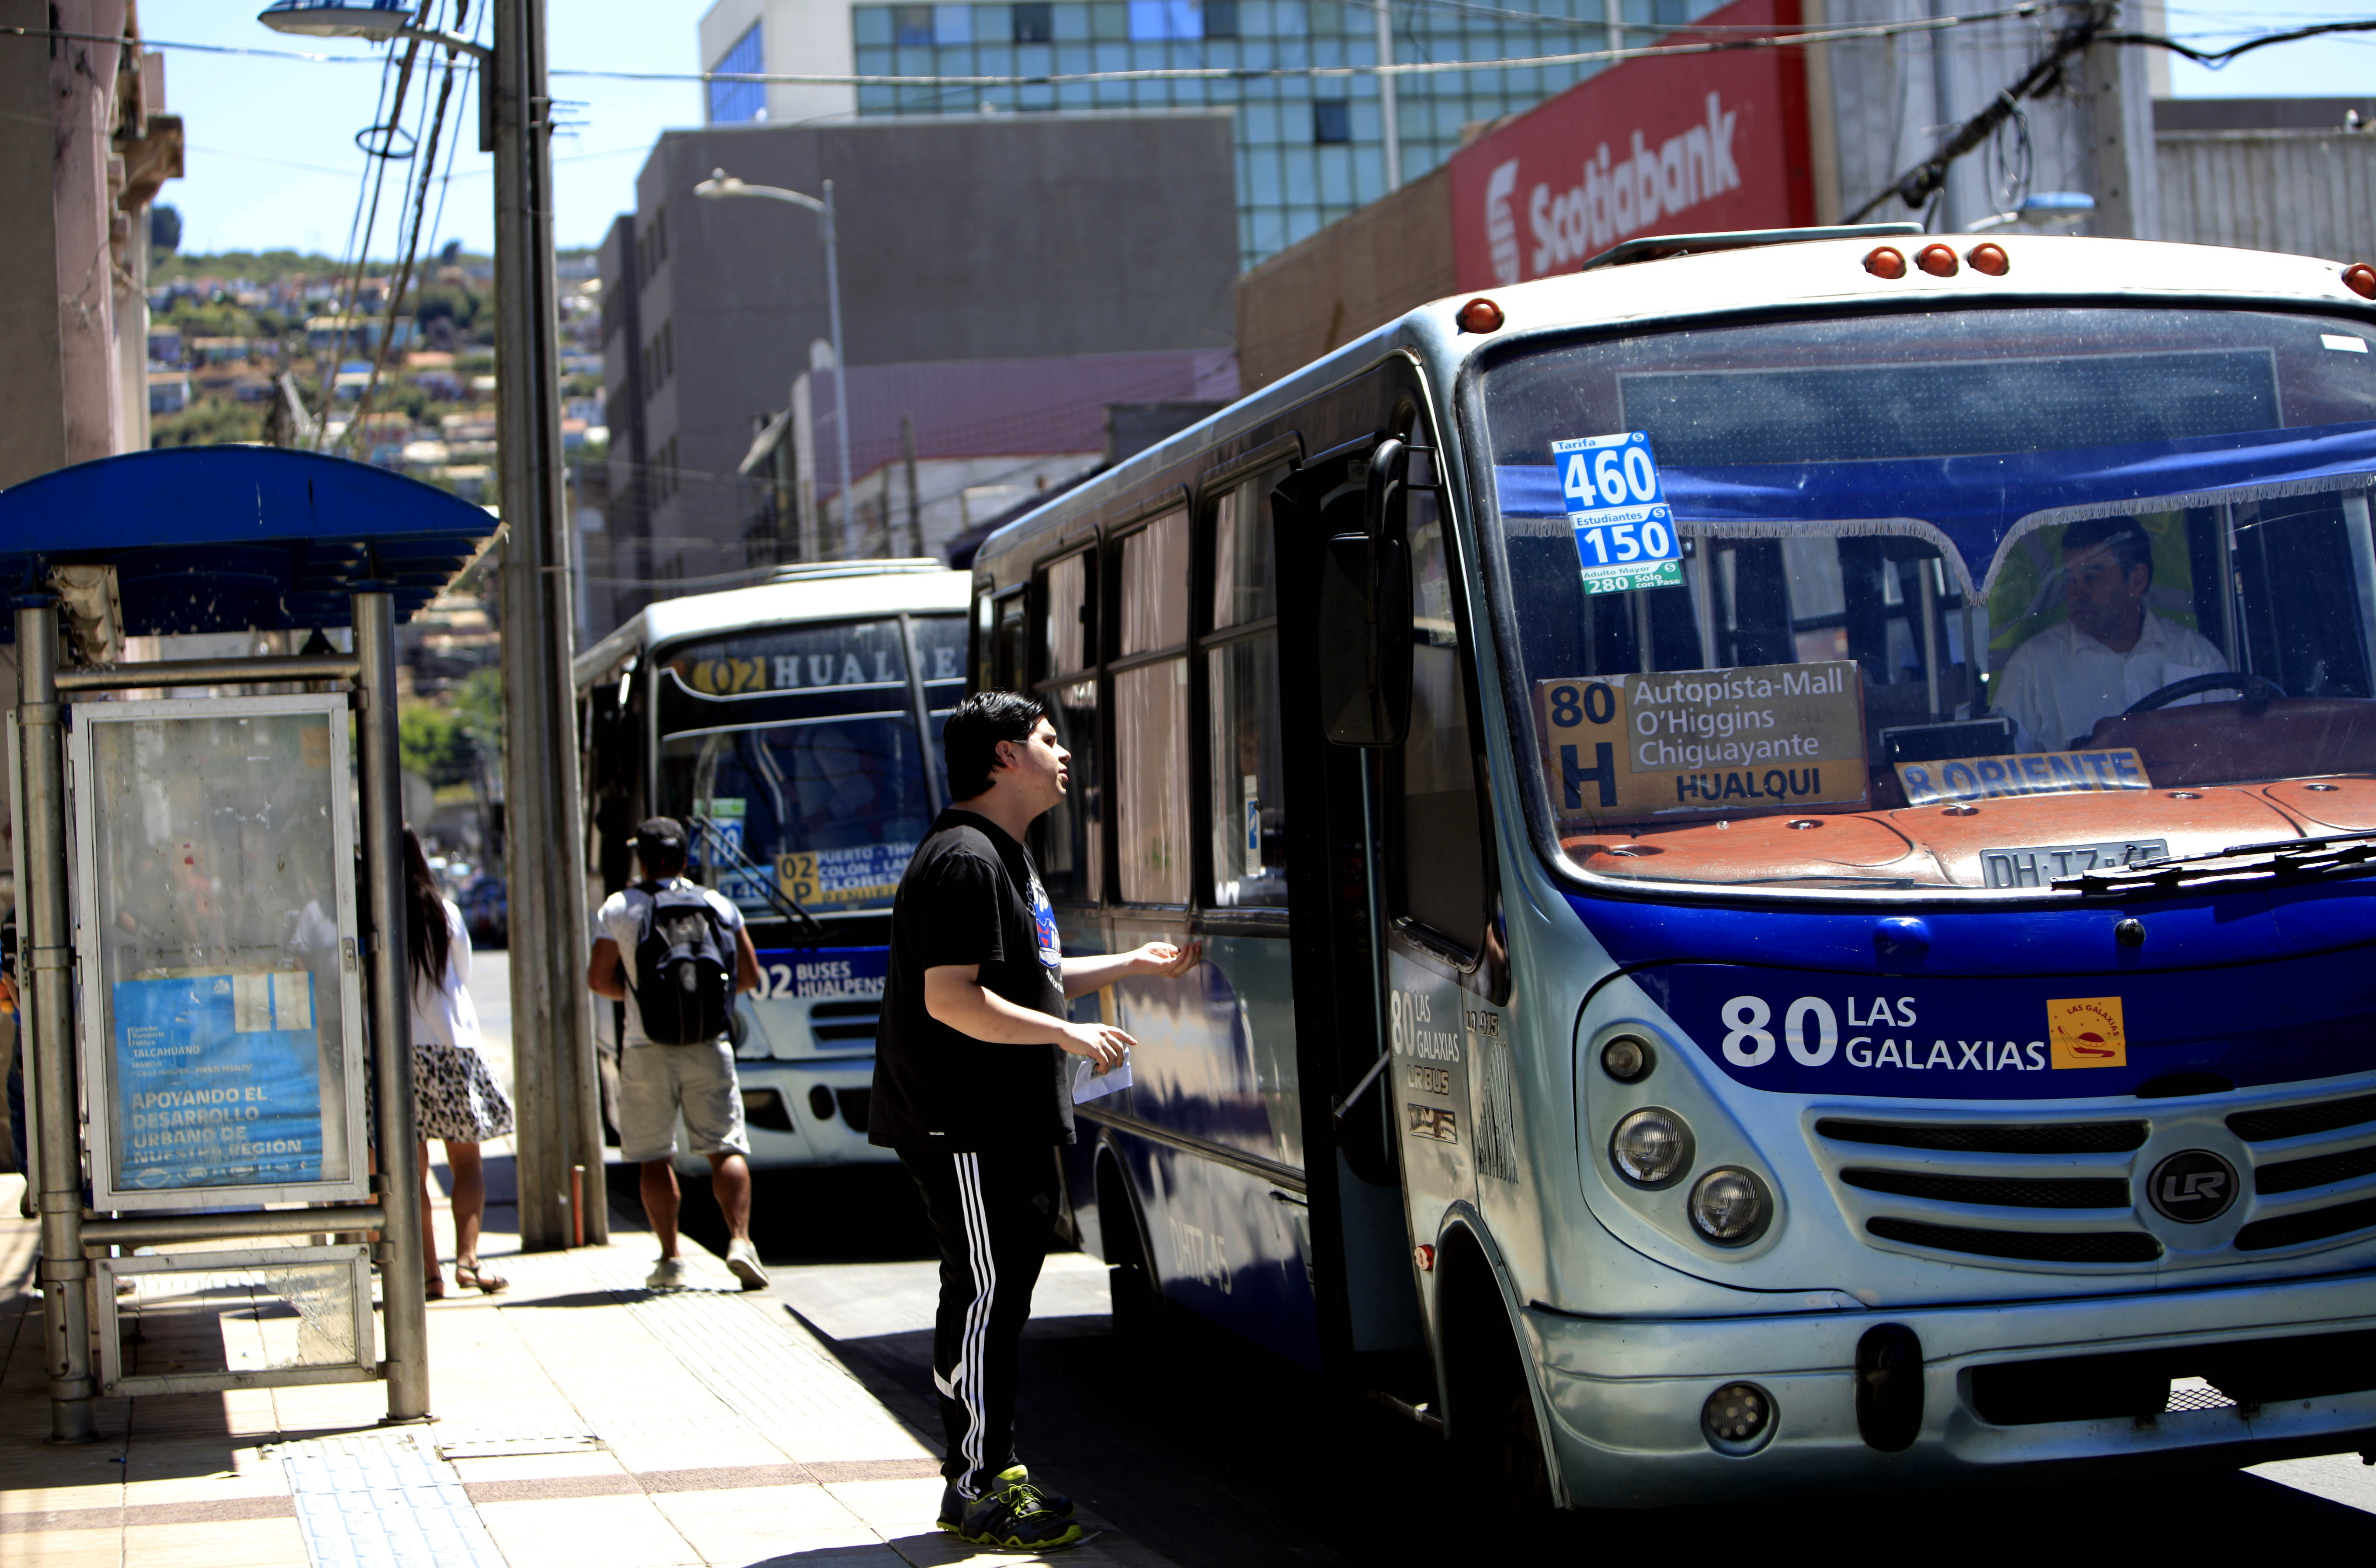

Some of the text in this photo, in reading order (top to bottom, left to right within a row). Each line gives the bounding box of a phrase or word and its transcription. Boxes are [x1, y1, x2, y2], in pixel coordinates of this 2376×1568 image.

[1529, 91, 1741, 275] Scotiabank
[1557, 438, 1596, 450] Tarifa
[1564, 447, 1656, 506] 460
[1576, 510, 1643, 526] Estudiantes
[1584, 521, 1669, 563] 150
[1584, 569, 1616, 579] Adulto
[1619, 565, 1650, 574] Mayor
[1589, 577, 1629, 593] 280
[1635, 573, 1662, 583] Sólo
[711, 658, 760, 694] 02
[1633, 667, 1843, 707] Autopista-Mall
[1550, 682, 1616, 728] 80
[1636, 706, 1775, 739] O'Higgins
[1638, 732, 1820, 769] Chiguayante
[1560, 742, 1618, 810] H
[1676, 768, 1821, 802] HUALQUI
[1904, 751, 2150, 805] 8 ORIENTE
[782, 857, 813, 879] 02
[818, 848, 873, 865] PUERTO
[793, 881, 811, 904] P
[748, 963, 793, 1001] 02
[796, 961, 851, 981] BUSES
[1391, 990, 1415, 1057] 80
[1414, 993, 1431, 1023] LAS
[1848, 996, 1917, 1027] LAS
[2067, 1004, 2119, 1036] LAS GALAXIAS
[1480, 1010, 1499, 1038] 915
[1721, 995, 1838, 1068] 80
[133, 1045, 200, 1058] TALCAHUANO
[1417, 1030, 1459, 1062] GALAXIAS
[1845, 1037, 2045, 1071] GALAXIAS
[132, 1088, 239, 1109] APOYANDO
[133, 1106, 259, 1130] DESARROLLO
[134, 1126, 247, 1149] URBANO DE
[229, 1138, 302, 1156] REGIÓN
[2162, 1171, 2226, 1202] LR
